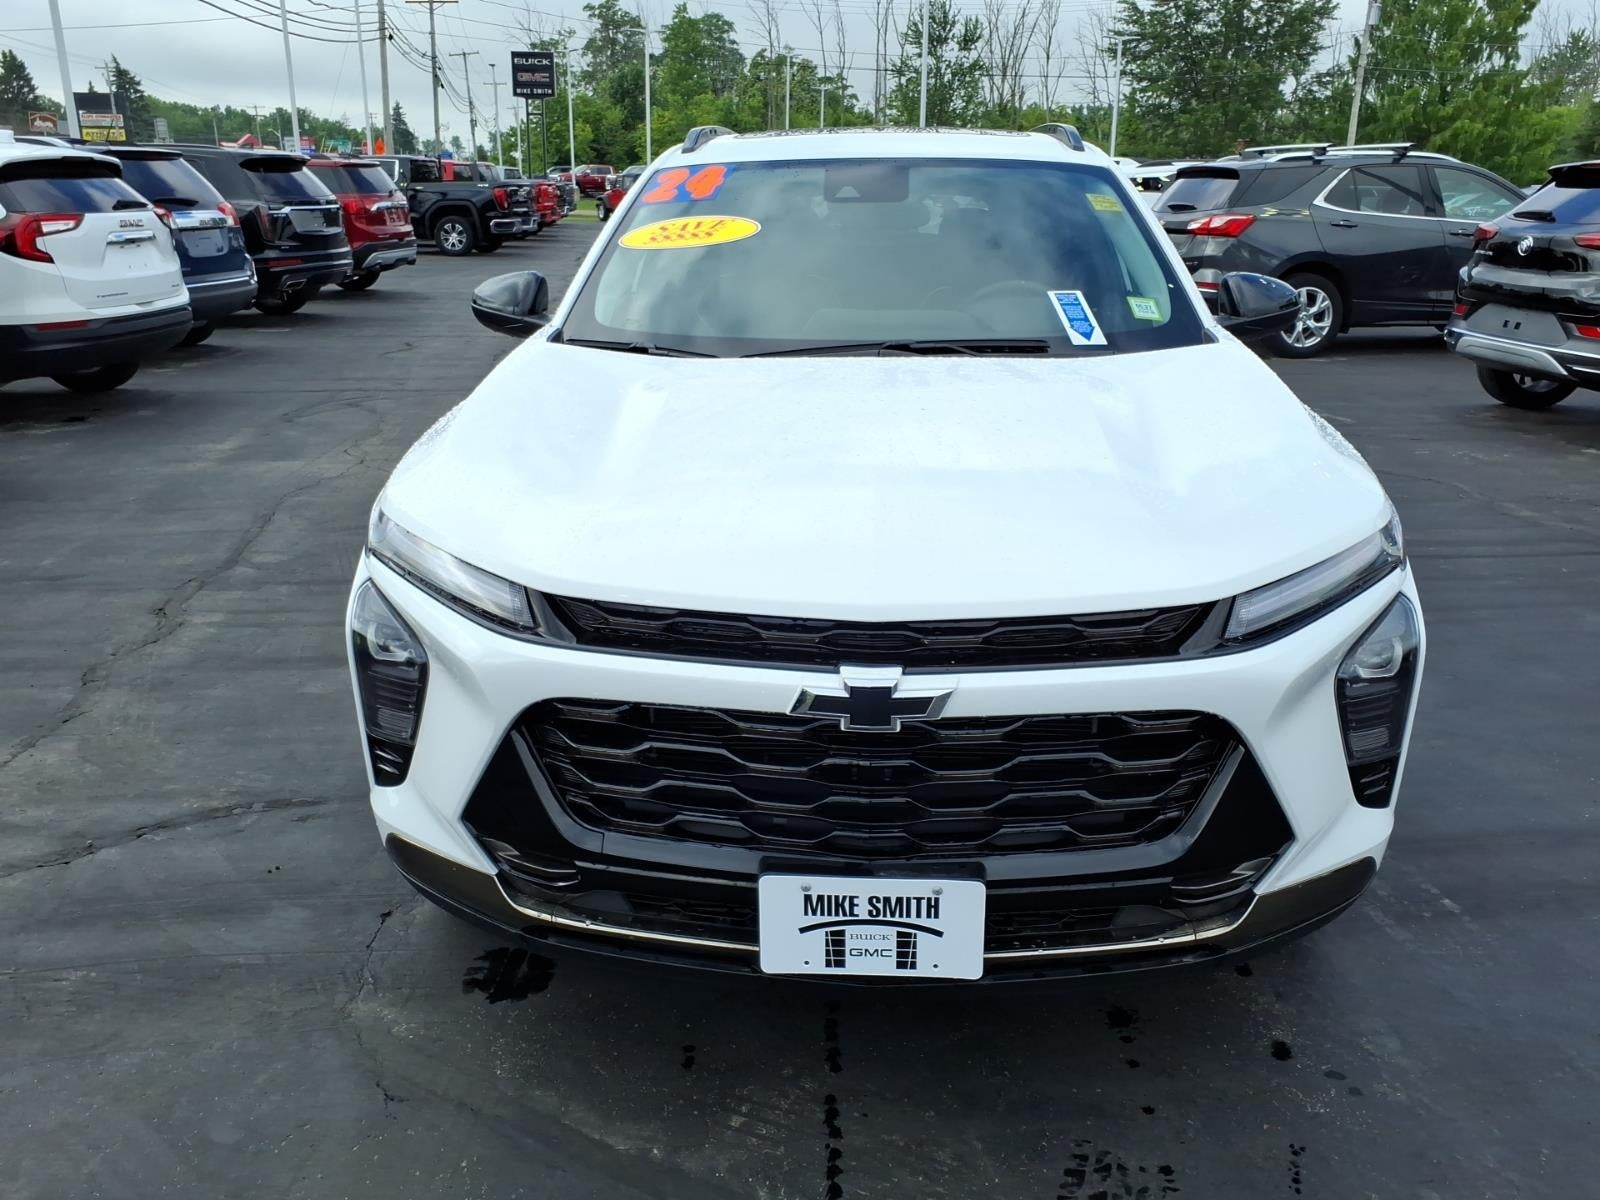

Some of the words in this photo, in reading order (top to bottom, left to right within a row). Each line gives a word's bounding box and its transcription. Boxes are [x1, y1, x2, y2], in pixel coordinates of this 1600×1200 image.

[517, 72, 550, 82] GMC
[642, 164, 727, 204] 24
[803, 894, 859, 917] MIKE
[867, 896, 941, 919] SMITH
[850, 933, 891, 941] BUICK
[849, 948, 893, 958] GMC
